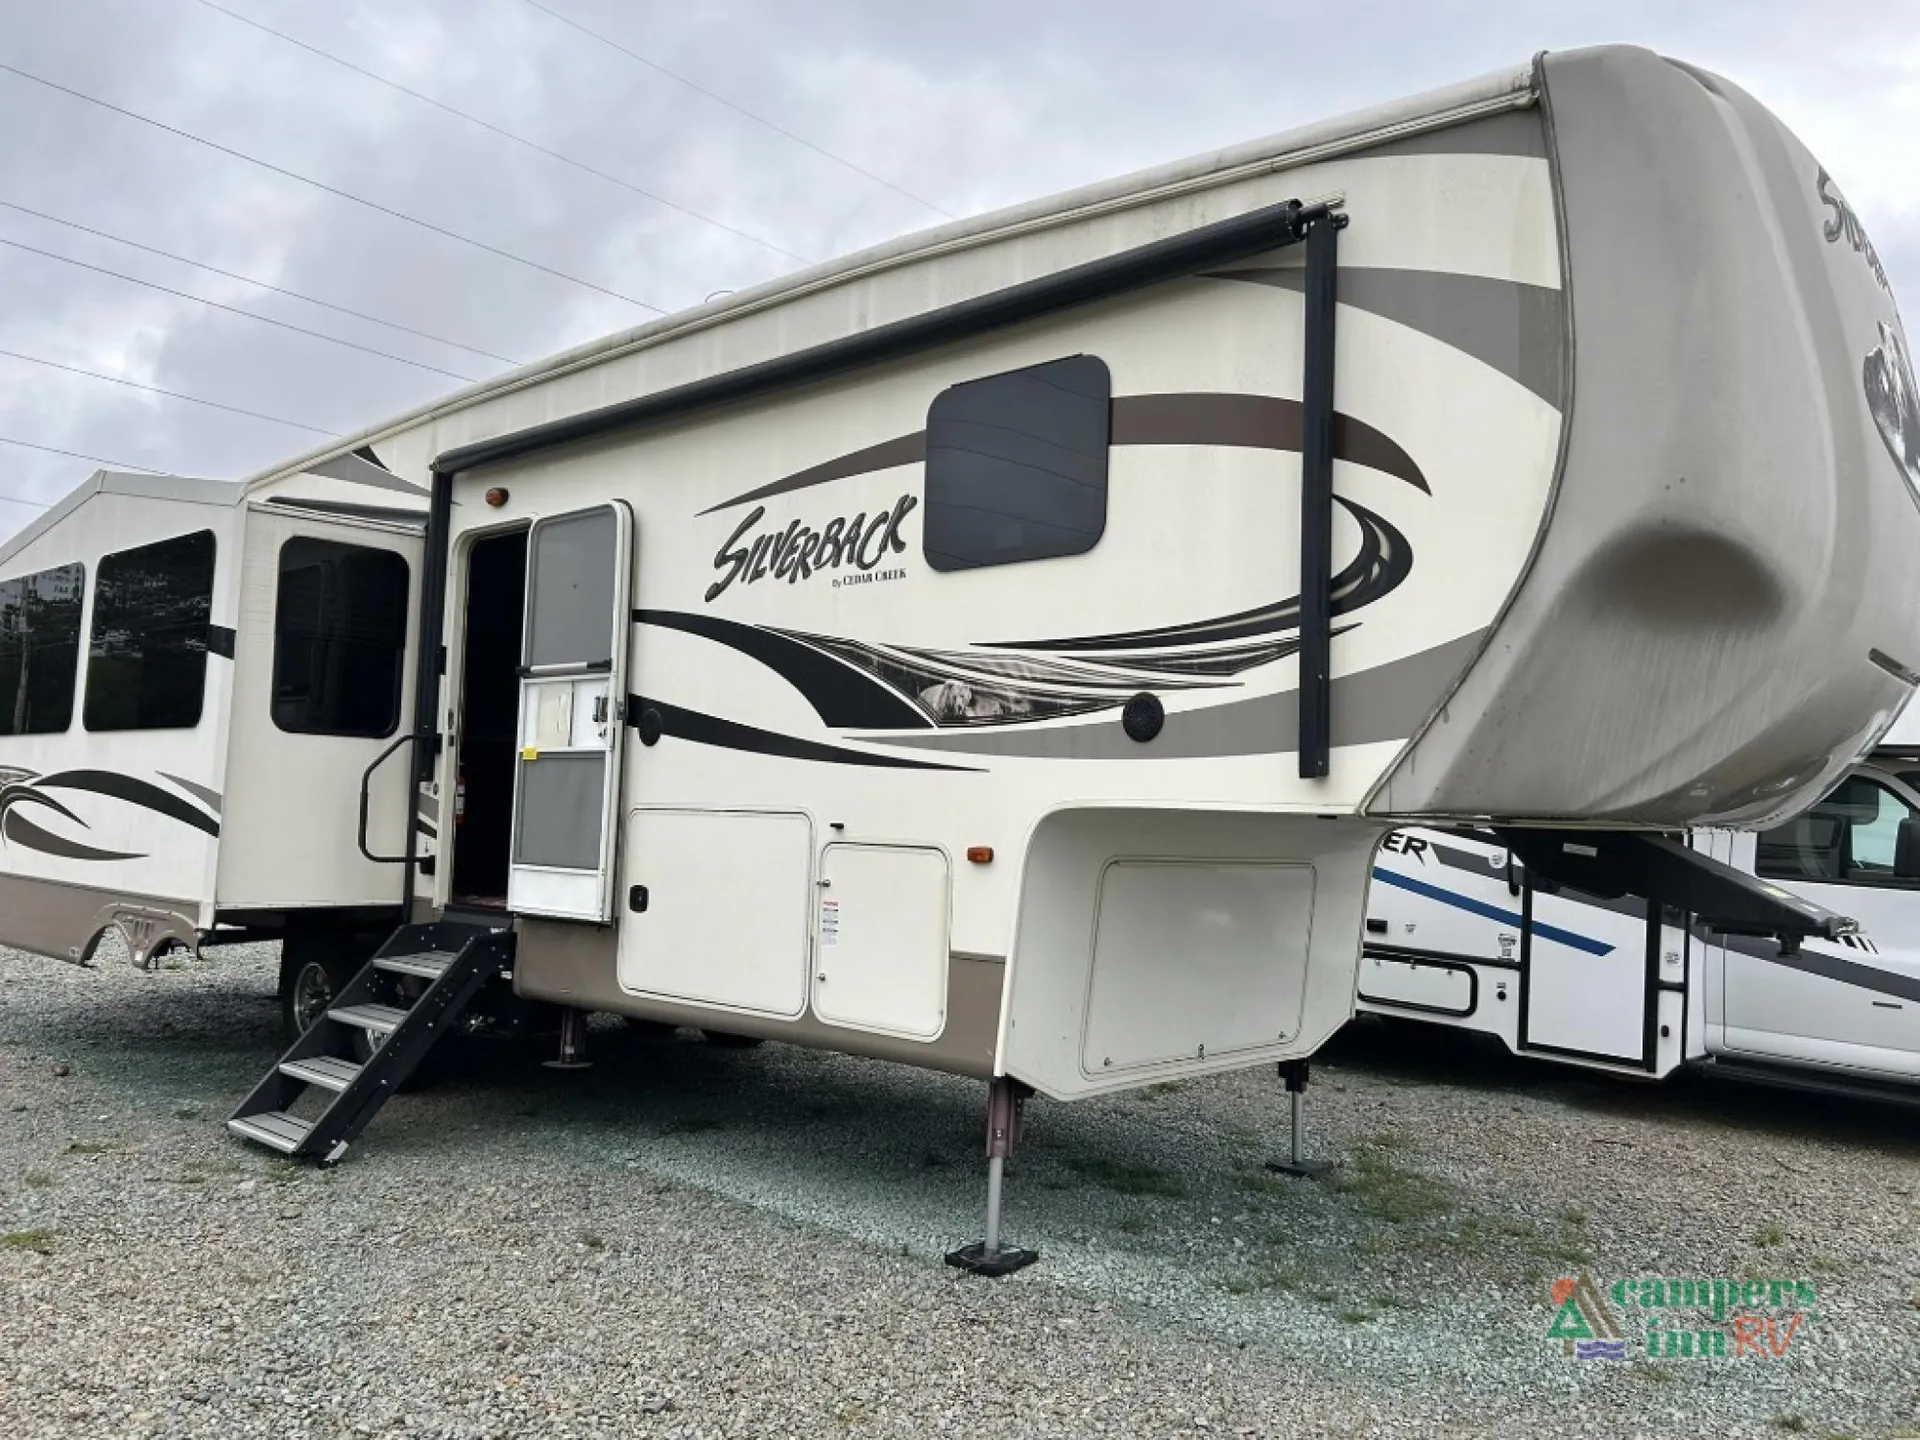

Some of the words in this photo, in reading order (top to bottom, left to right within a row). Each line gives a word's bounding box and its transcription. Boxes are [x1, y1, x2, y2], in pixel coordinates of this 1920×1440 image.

[705, 494, 918, 602] SILVERBACK
[875, 568, 906, 582] CREEK
[1380, 831, 1428, 867] ER
